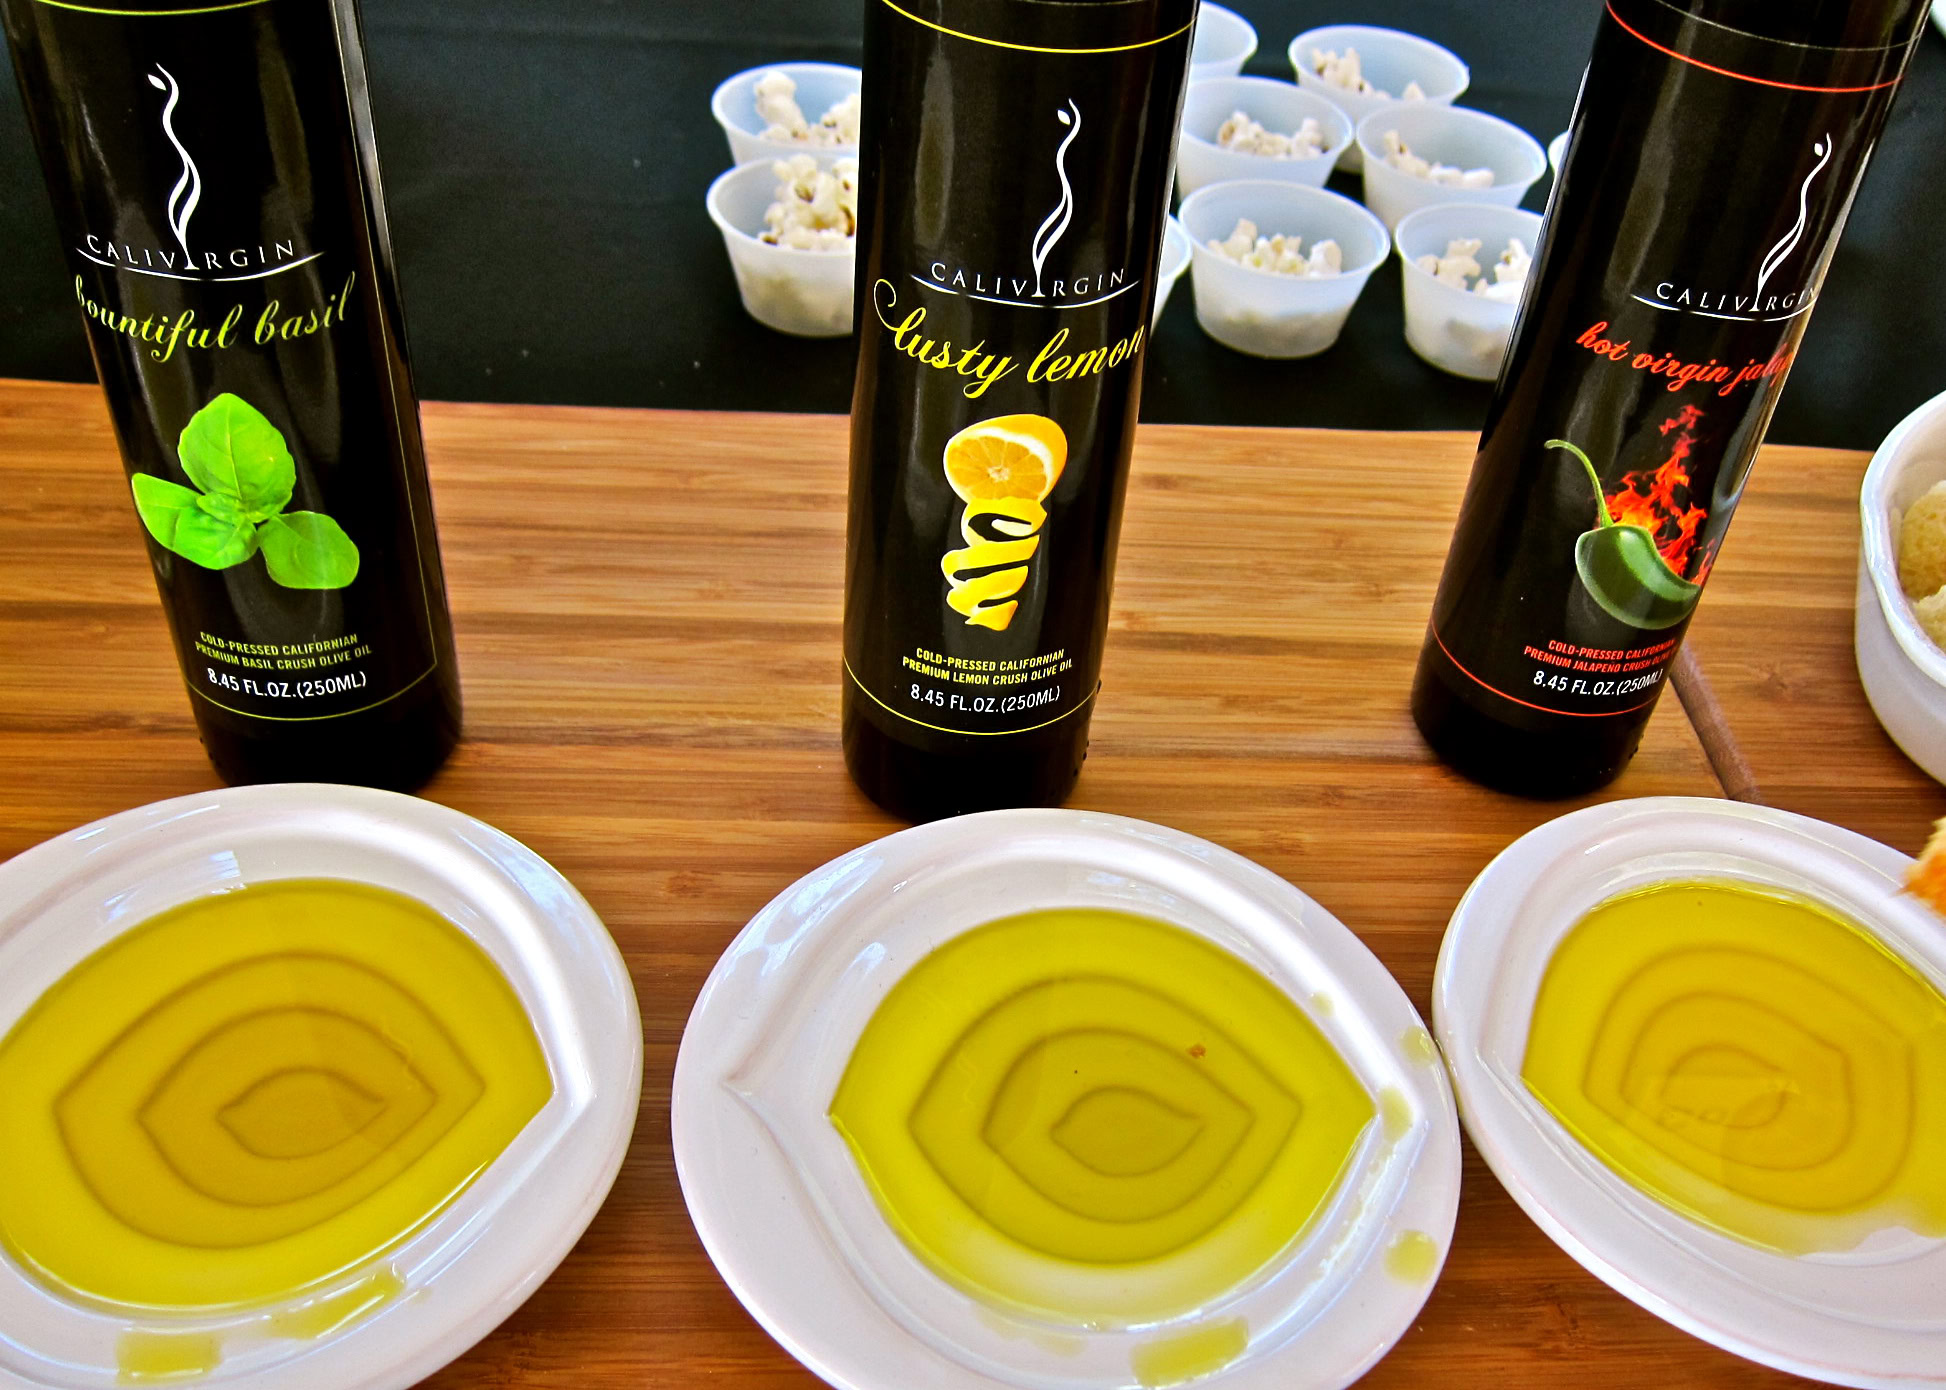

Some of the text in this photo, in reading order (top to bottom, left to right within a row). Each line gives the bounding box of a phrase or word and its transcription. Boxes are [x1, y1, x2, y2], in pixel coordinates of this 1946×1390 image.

[75, 271, 356, 363] bountiful basil
[873, 278, 1146, 399] lusty lemon
[1575, 321, 1631, 361] hot
[1632, 352, 1733, 392] virgin
[195, 641, 372, 670] PREMIUM BASIL CRUSH OLIVE OIL
[200, 631, 359, 656] COLD-PRESSED CALIFORNIAN
[1548, 639, 1623, 661] COLD-PRESSED
[902, 655, 1073, 686] PREMIUM LEMON CRUSH OLIVE OIL
[916, 647, 1065, 672] COLD-PRESSED CALIFORNIAN
[1523, 645, 1571, 669] PREMIUM
[1622, 659, 1652, 673] CRUSH
[207, 667, 240, 692] 8.45
[1533, 670, 1568, 692] 8.45
[910, 683, 945, 707] 8.45
